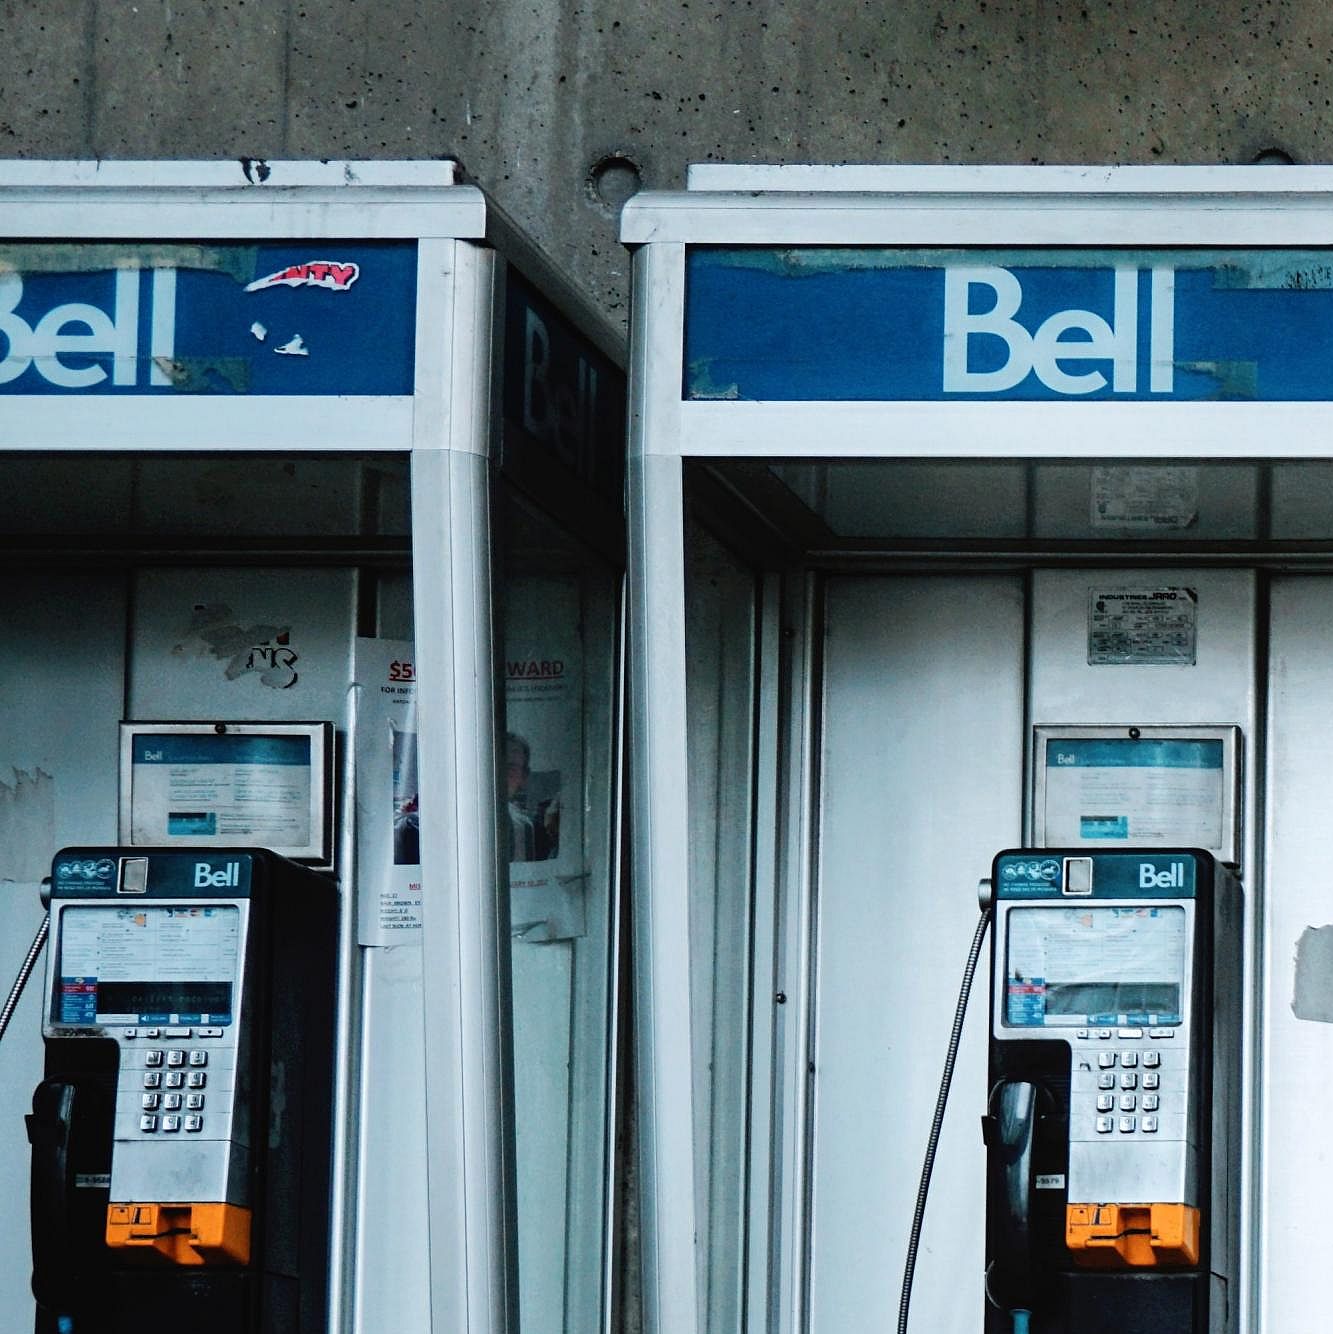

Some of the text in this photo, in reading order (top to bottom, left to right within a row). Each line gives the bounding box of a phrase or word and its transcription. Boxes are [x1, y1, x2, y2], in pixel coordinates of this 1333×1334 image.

[942, 264, 1175, 394] Bell
[389, 660, 564, 679] $5 WARD
[194, 862, 240, 888] Bell
[1139, 862, 1185, 889] Bell
